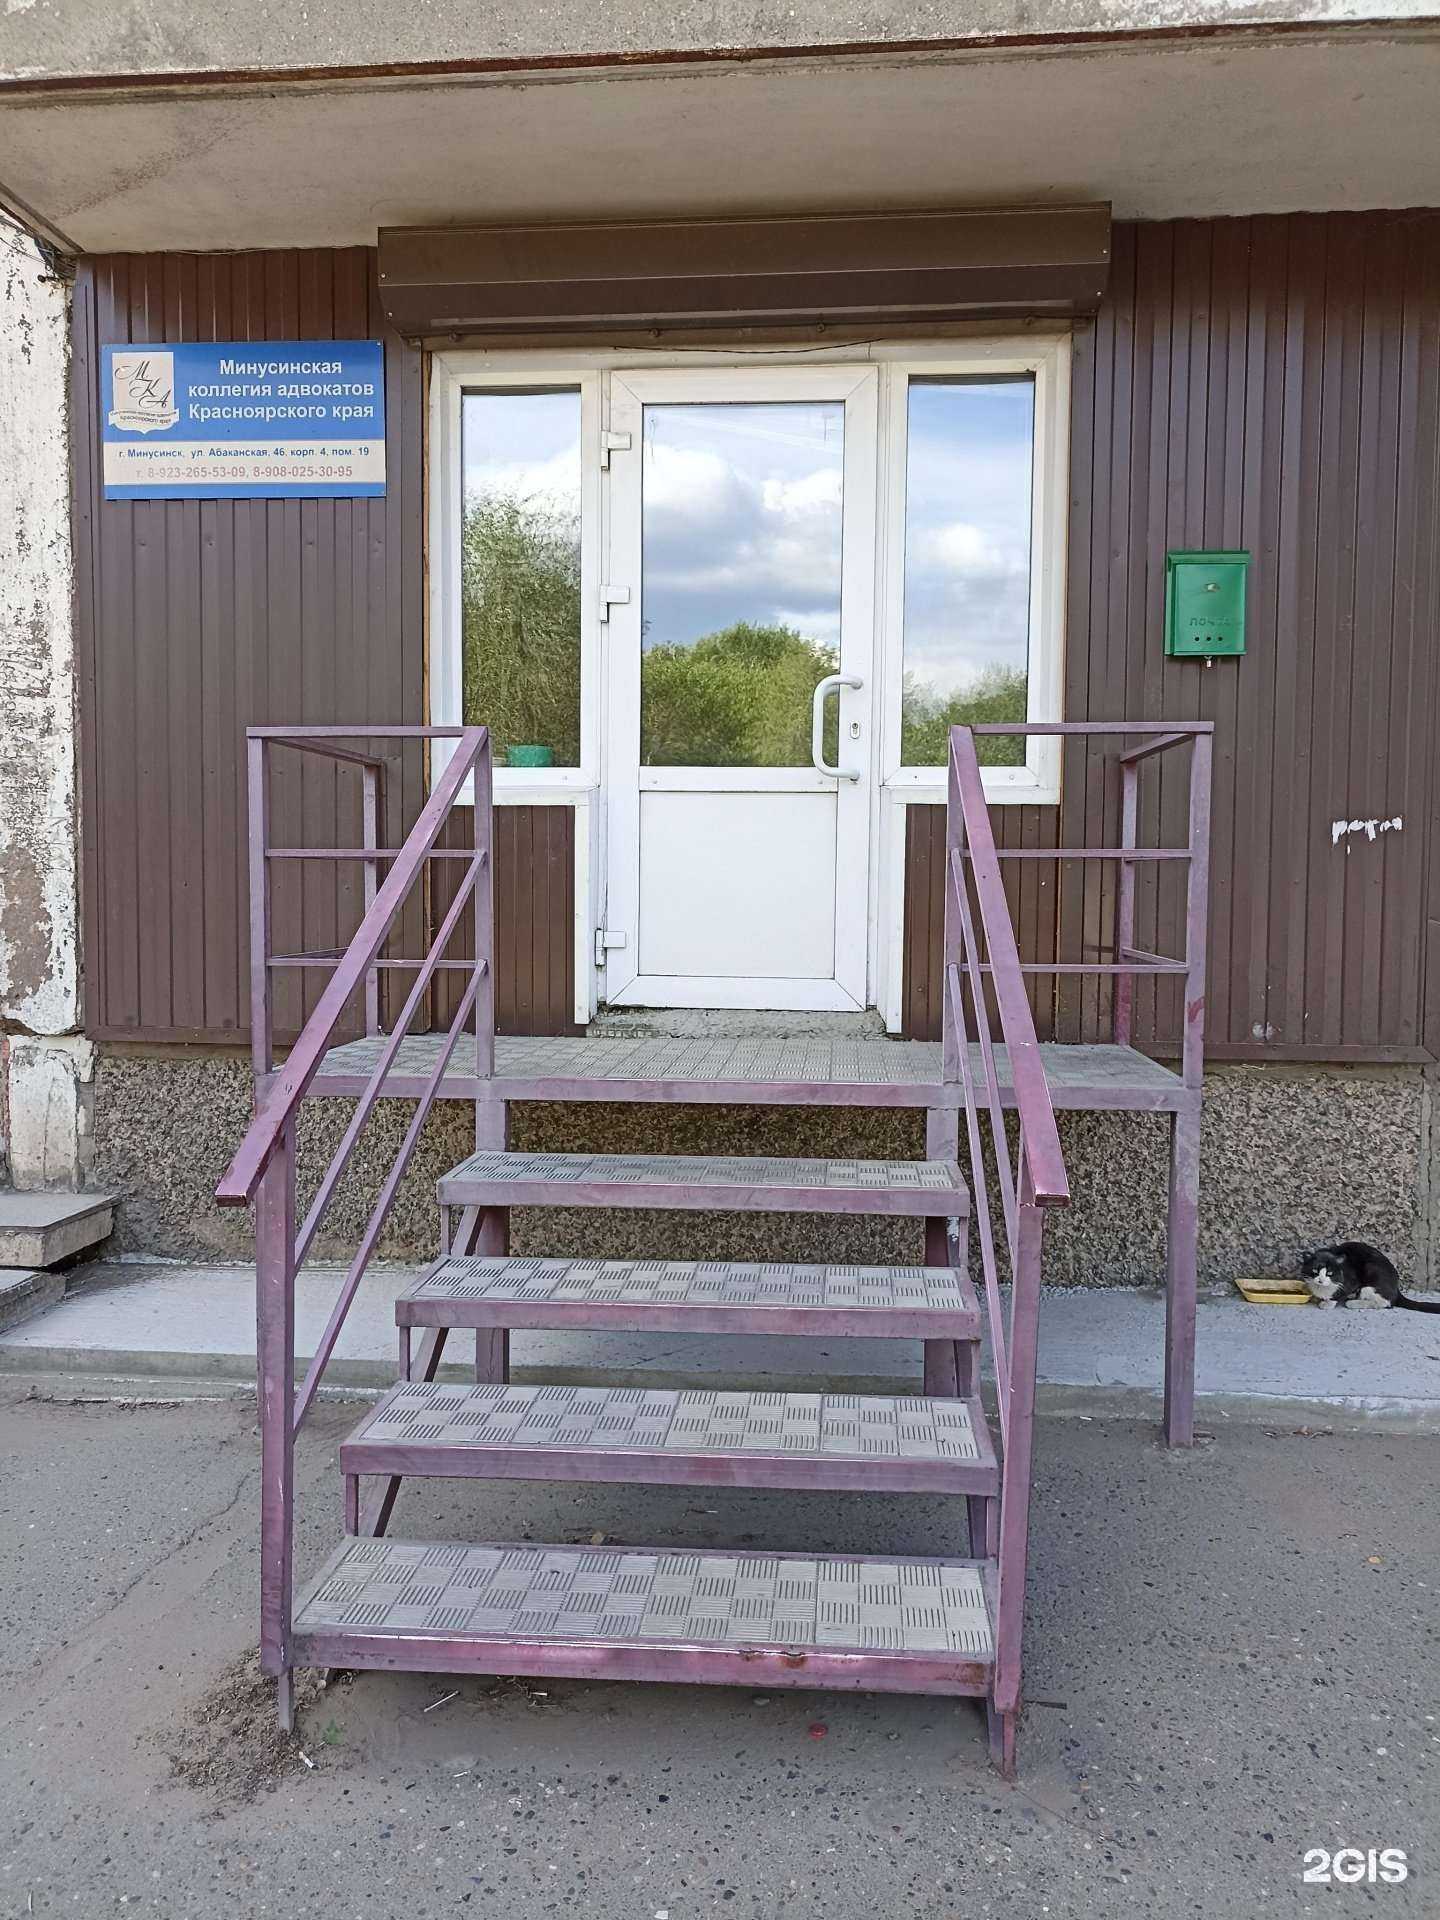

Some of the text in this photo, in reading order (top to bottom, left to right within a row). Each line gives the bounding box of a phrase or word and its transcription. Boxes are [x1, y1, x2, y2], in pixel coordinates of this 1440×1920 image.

[219, 359, 343, 378] Минусинская
[188, 383, 375, 399] коллегия адвокатов
[189, 403, 327, 422] Красноярского
[332, 405, 375, 421] края
[127, 448, 185, 459] Минусинск,
[208, 447, 271, 457] Абаканская,
[290, 449, 317, 457] корп.
[358, 447, 369, 456] 19
[252, 465, 354, 478] 8-908-025-30-95
